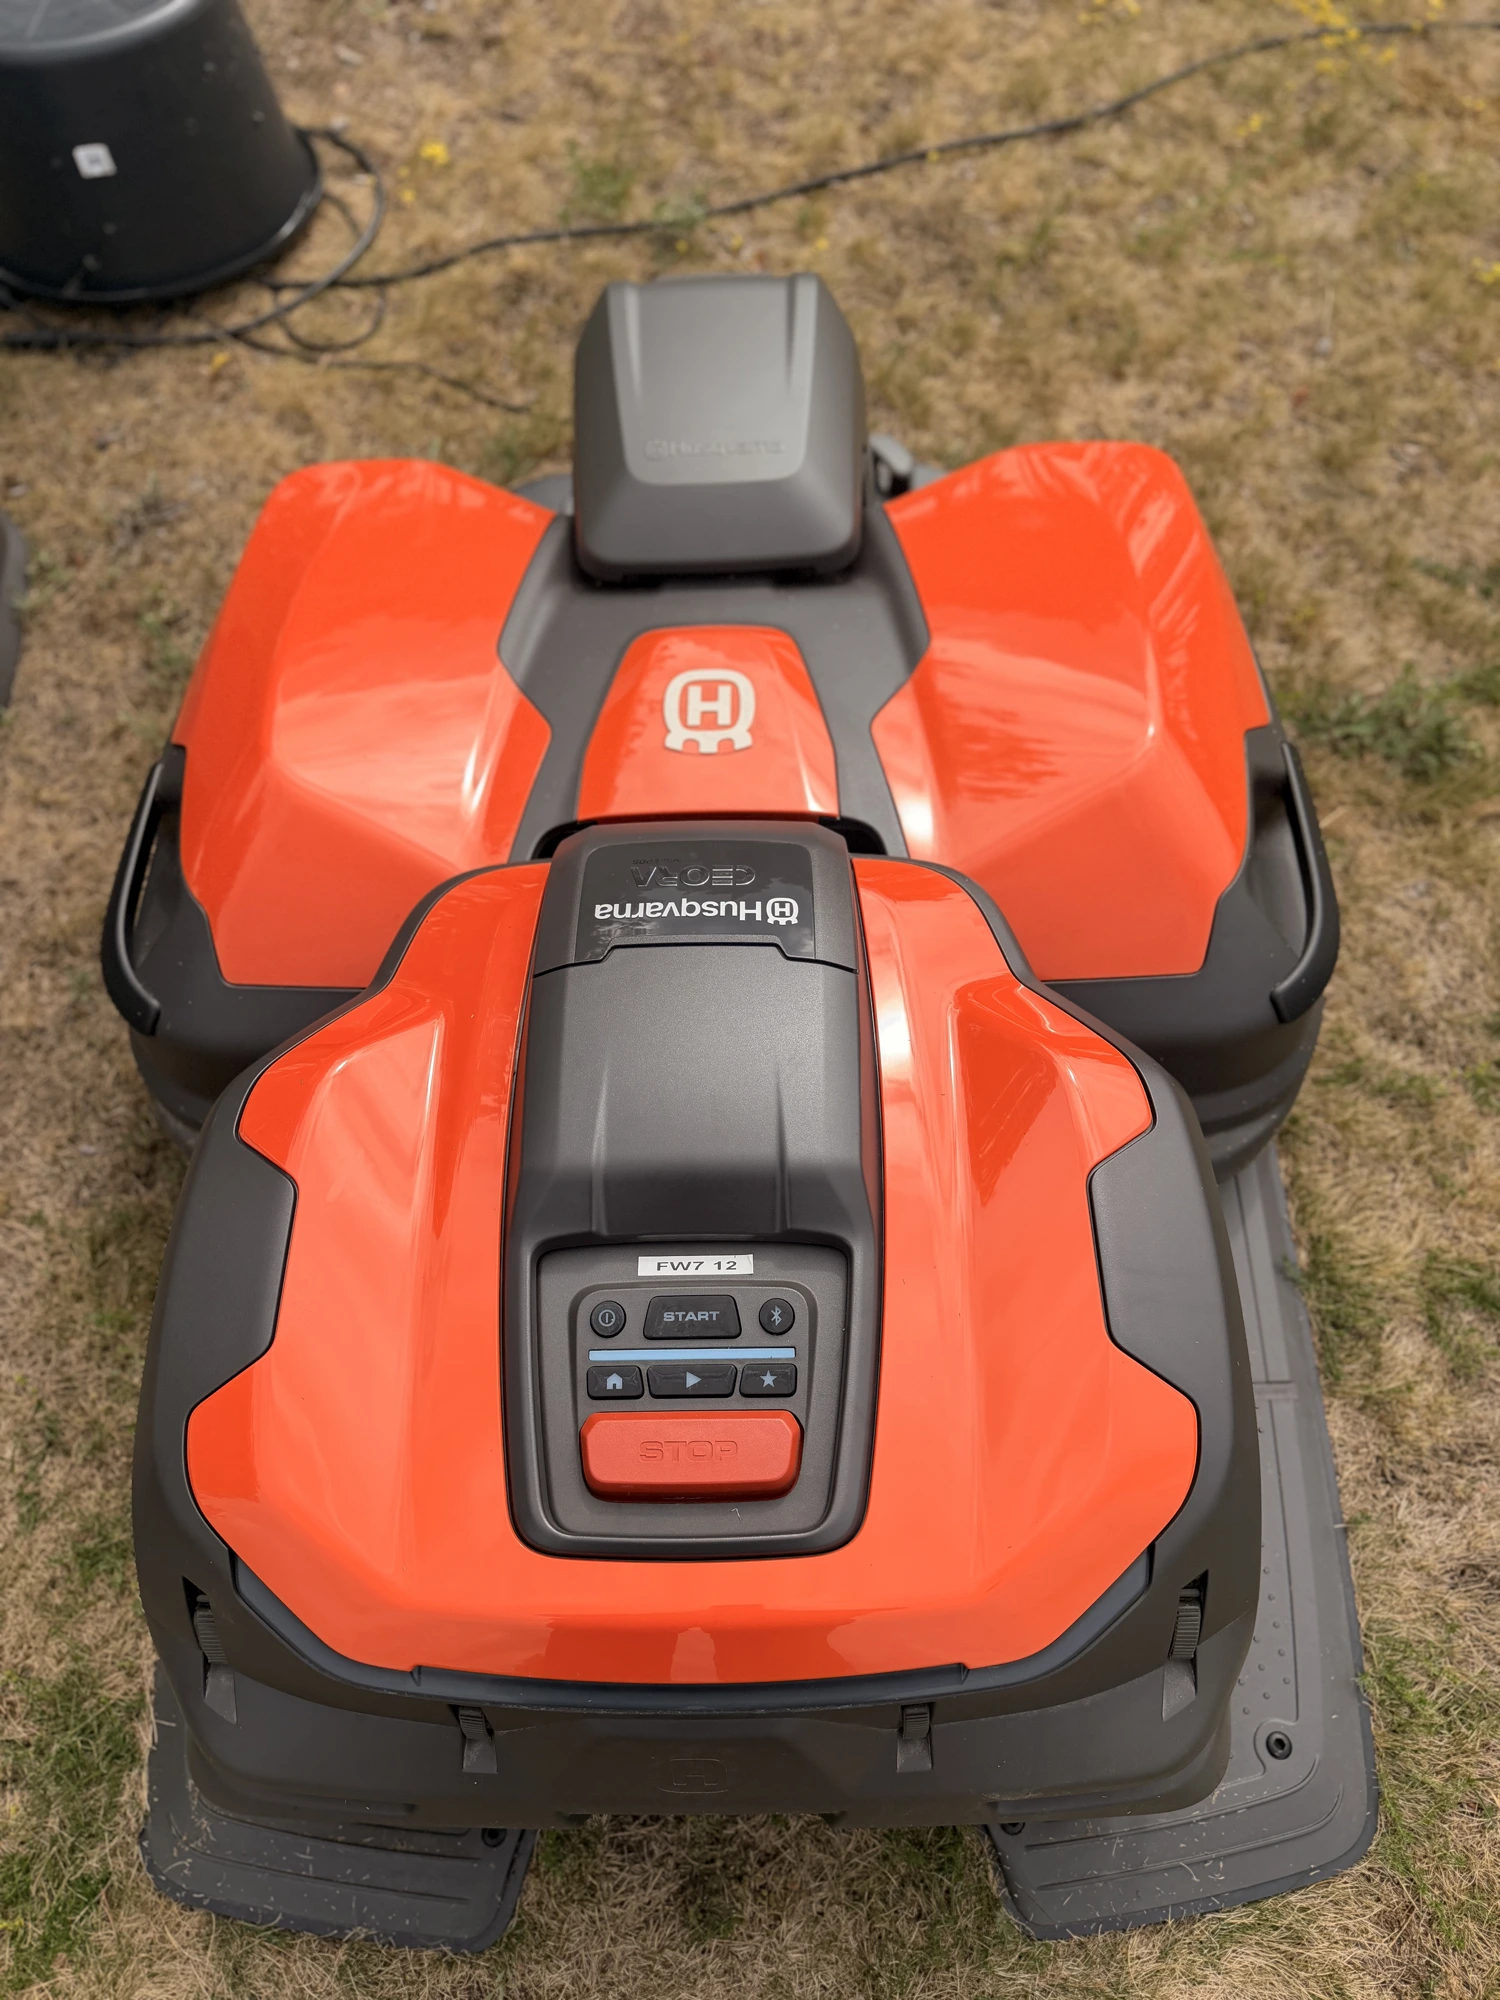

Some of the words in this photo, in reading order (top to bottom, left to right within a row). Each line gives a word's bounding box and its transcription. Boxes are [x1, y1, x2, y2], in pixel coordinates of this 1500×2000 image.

[629, 865, 756, 886] CEORA
[594, 898, 762, 921] Husqvarna
[656, 1261, 705, 1271] FW7
[713, 1260, 737, 1271] 12
[663, 1311, 720, 1322] START
[639, 1440, 739, 1462] STOP
